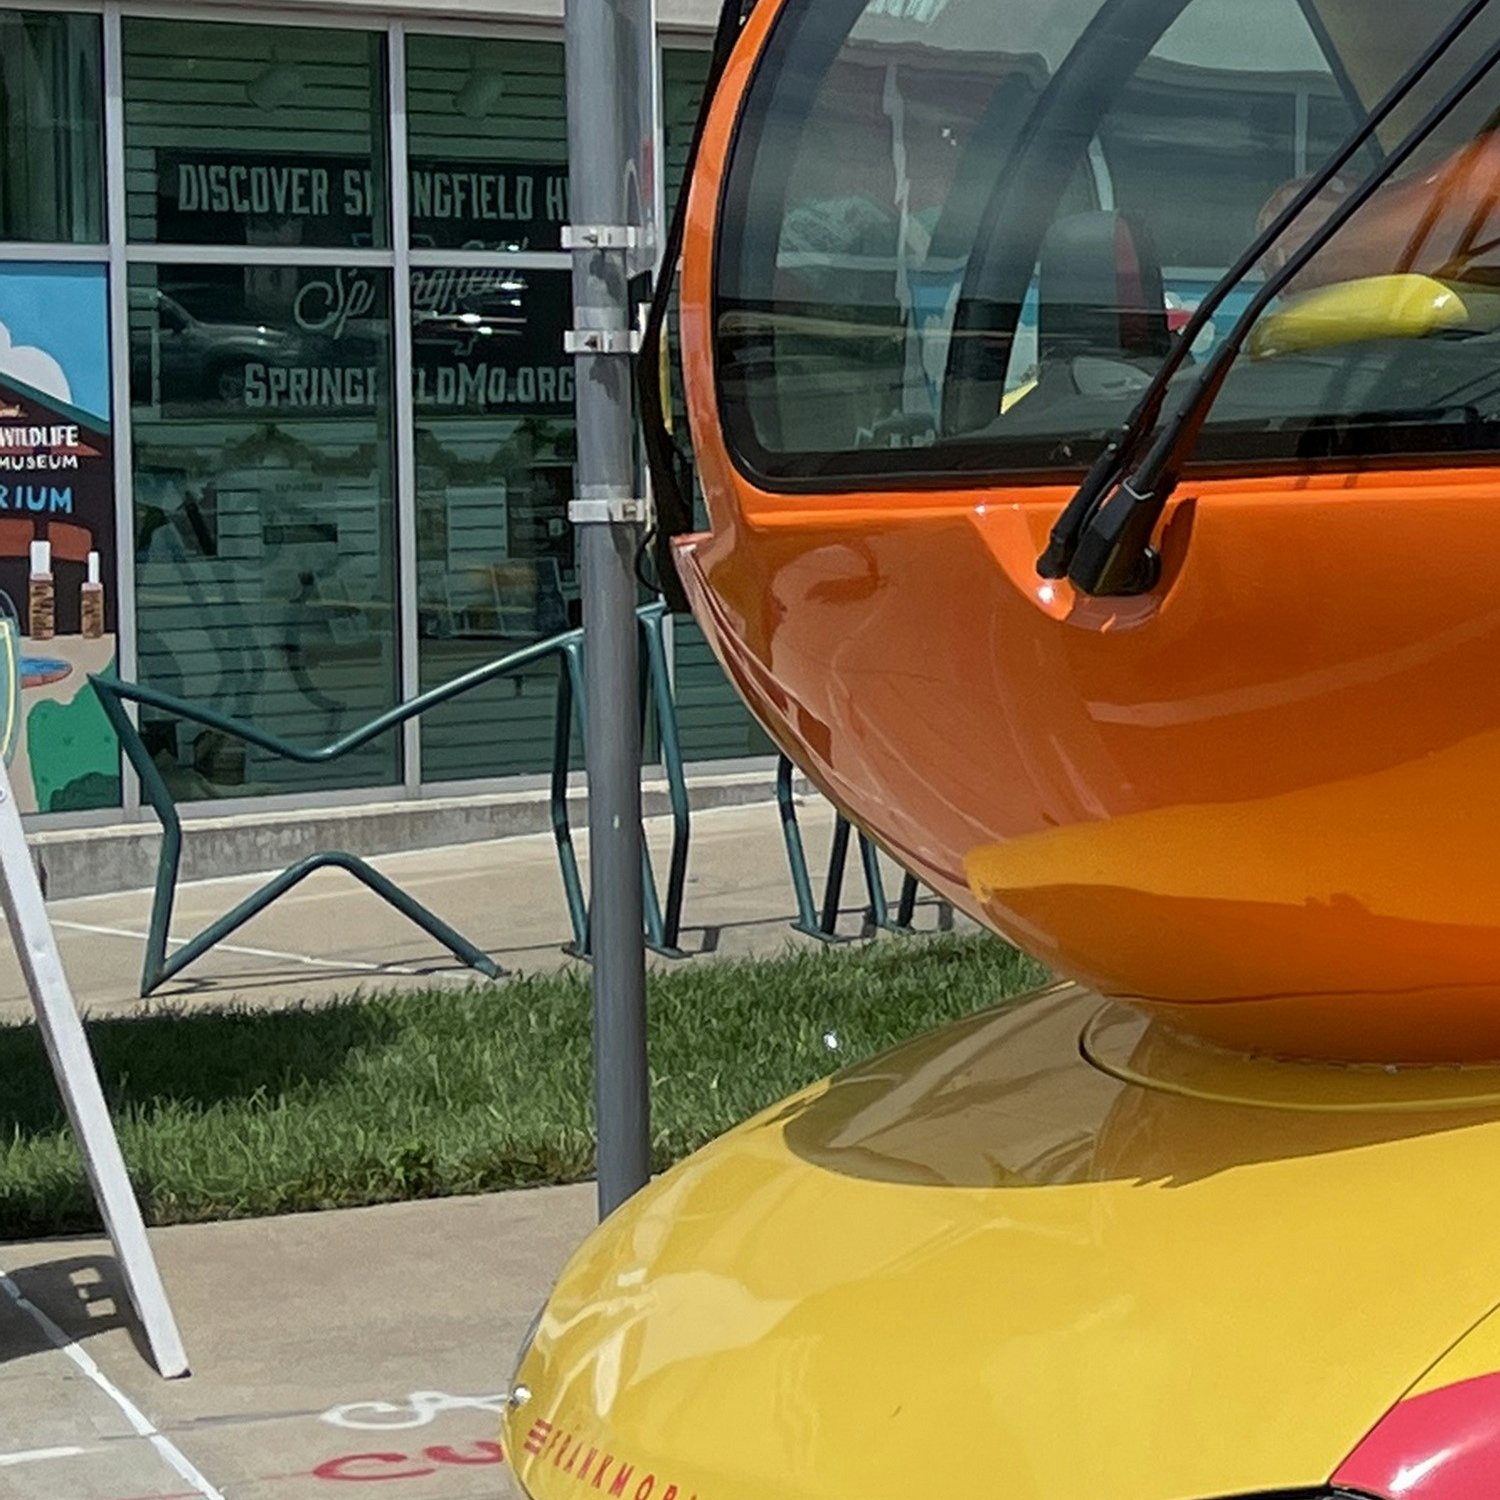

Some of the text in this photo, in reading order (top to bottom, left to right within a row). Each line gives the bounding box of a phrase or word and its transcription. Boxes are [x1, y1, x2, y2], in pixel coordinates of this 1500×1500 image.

[178, 164, 329, 216] DISCOVER
[344, 169, 532, 221] SNGFIELD
[0, 425, 78, 447] WILDLIFE
[0, 454, 78, 470] MUSEUM
